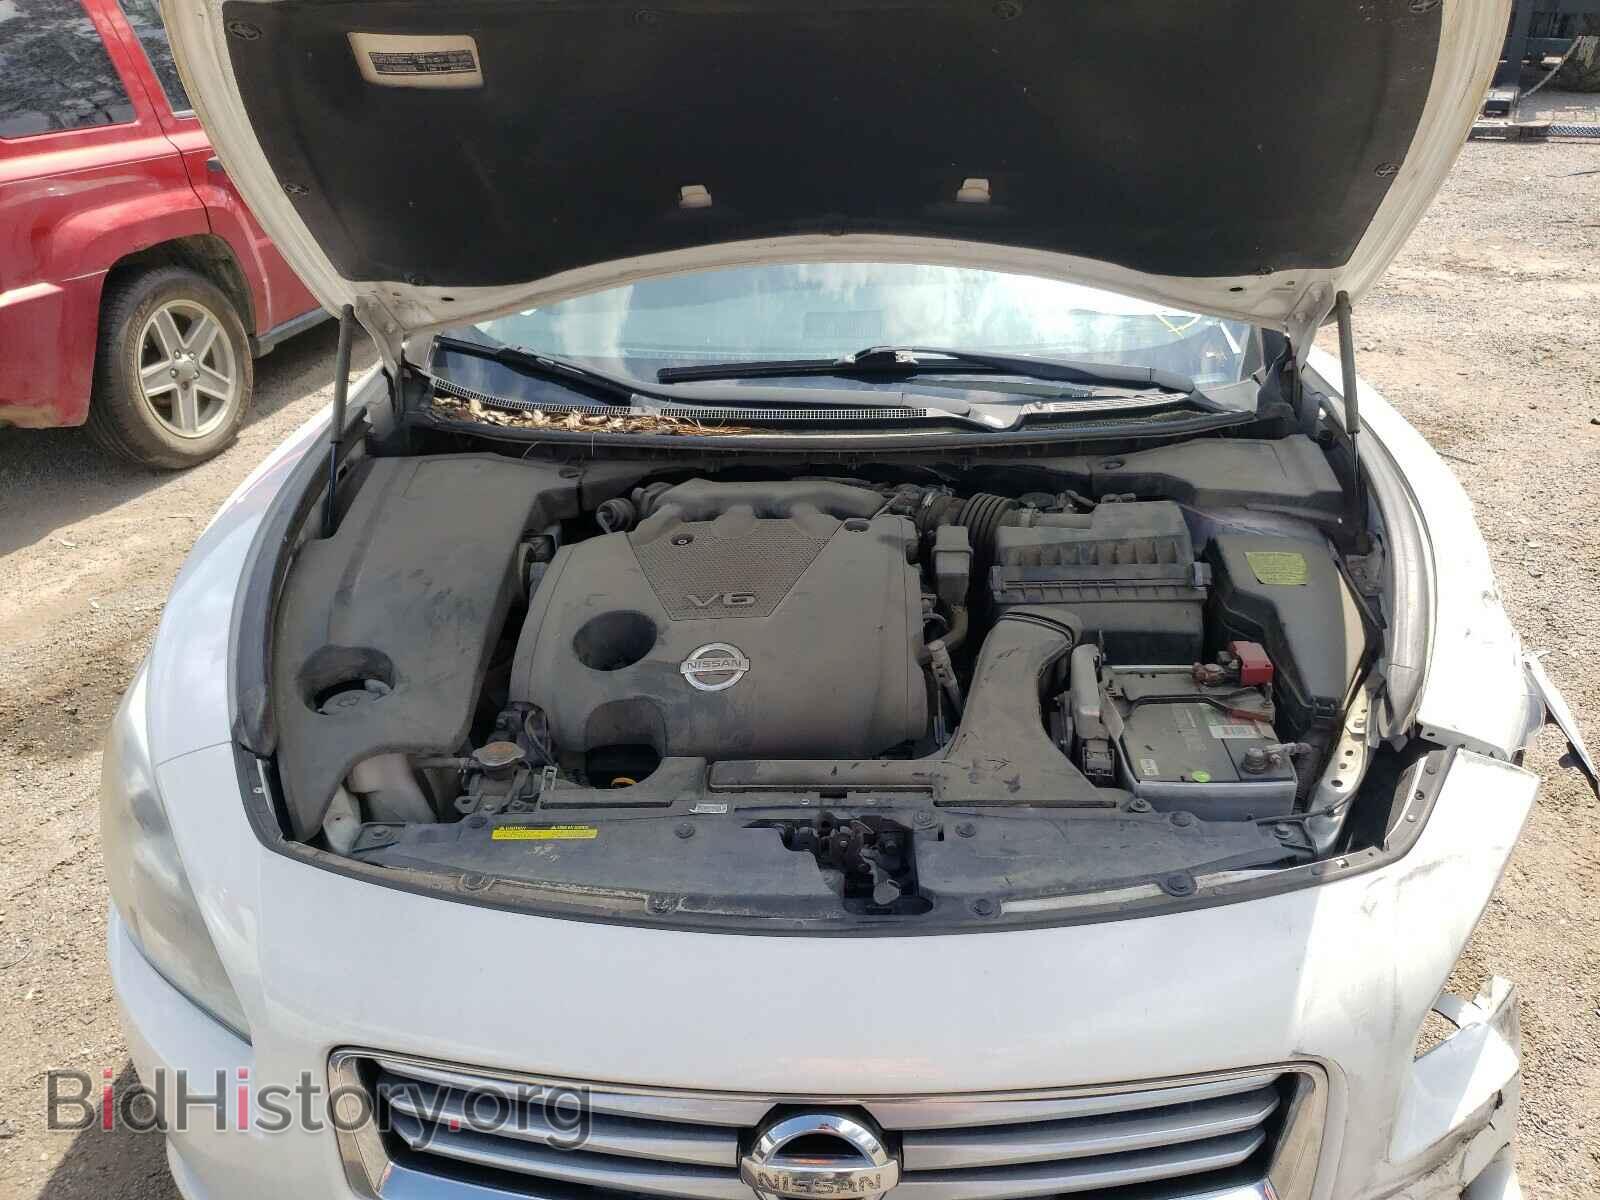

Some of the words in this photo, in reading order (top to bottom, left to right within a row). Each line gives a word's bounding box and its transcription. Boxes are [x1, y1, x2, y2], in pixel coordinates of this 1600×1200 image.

[687, 591, 756, 607] V6
[687, 660, 742, 670] NISSAN
[758, 1172, 882, 1194] NISSAN
